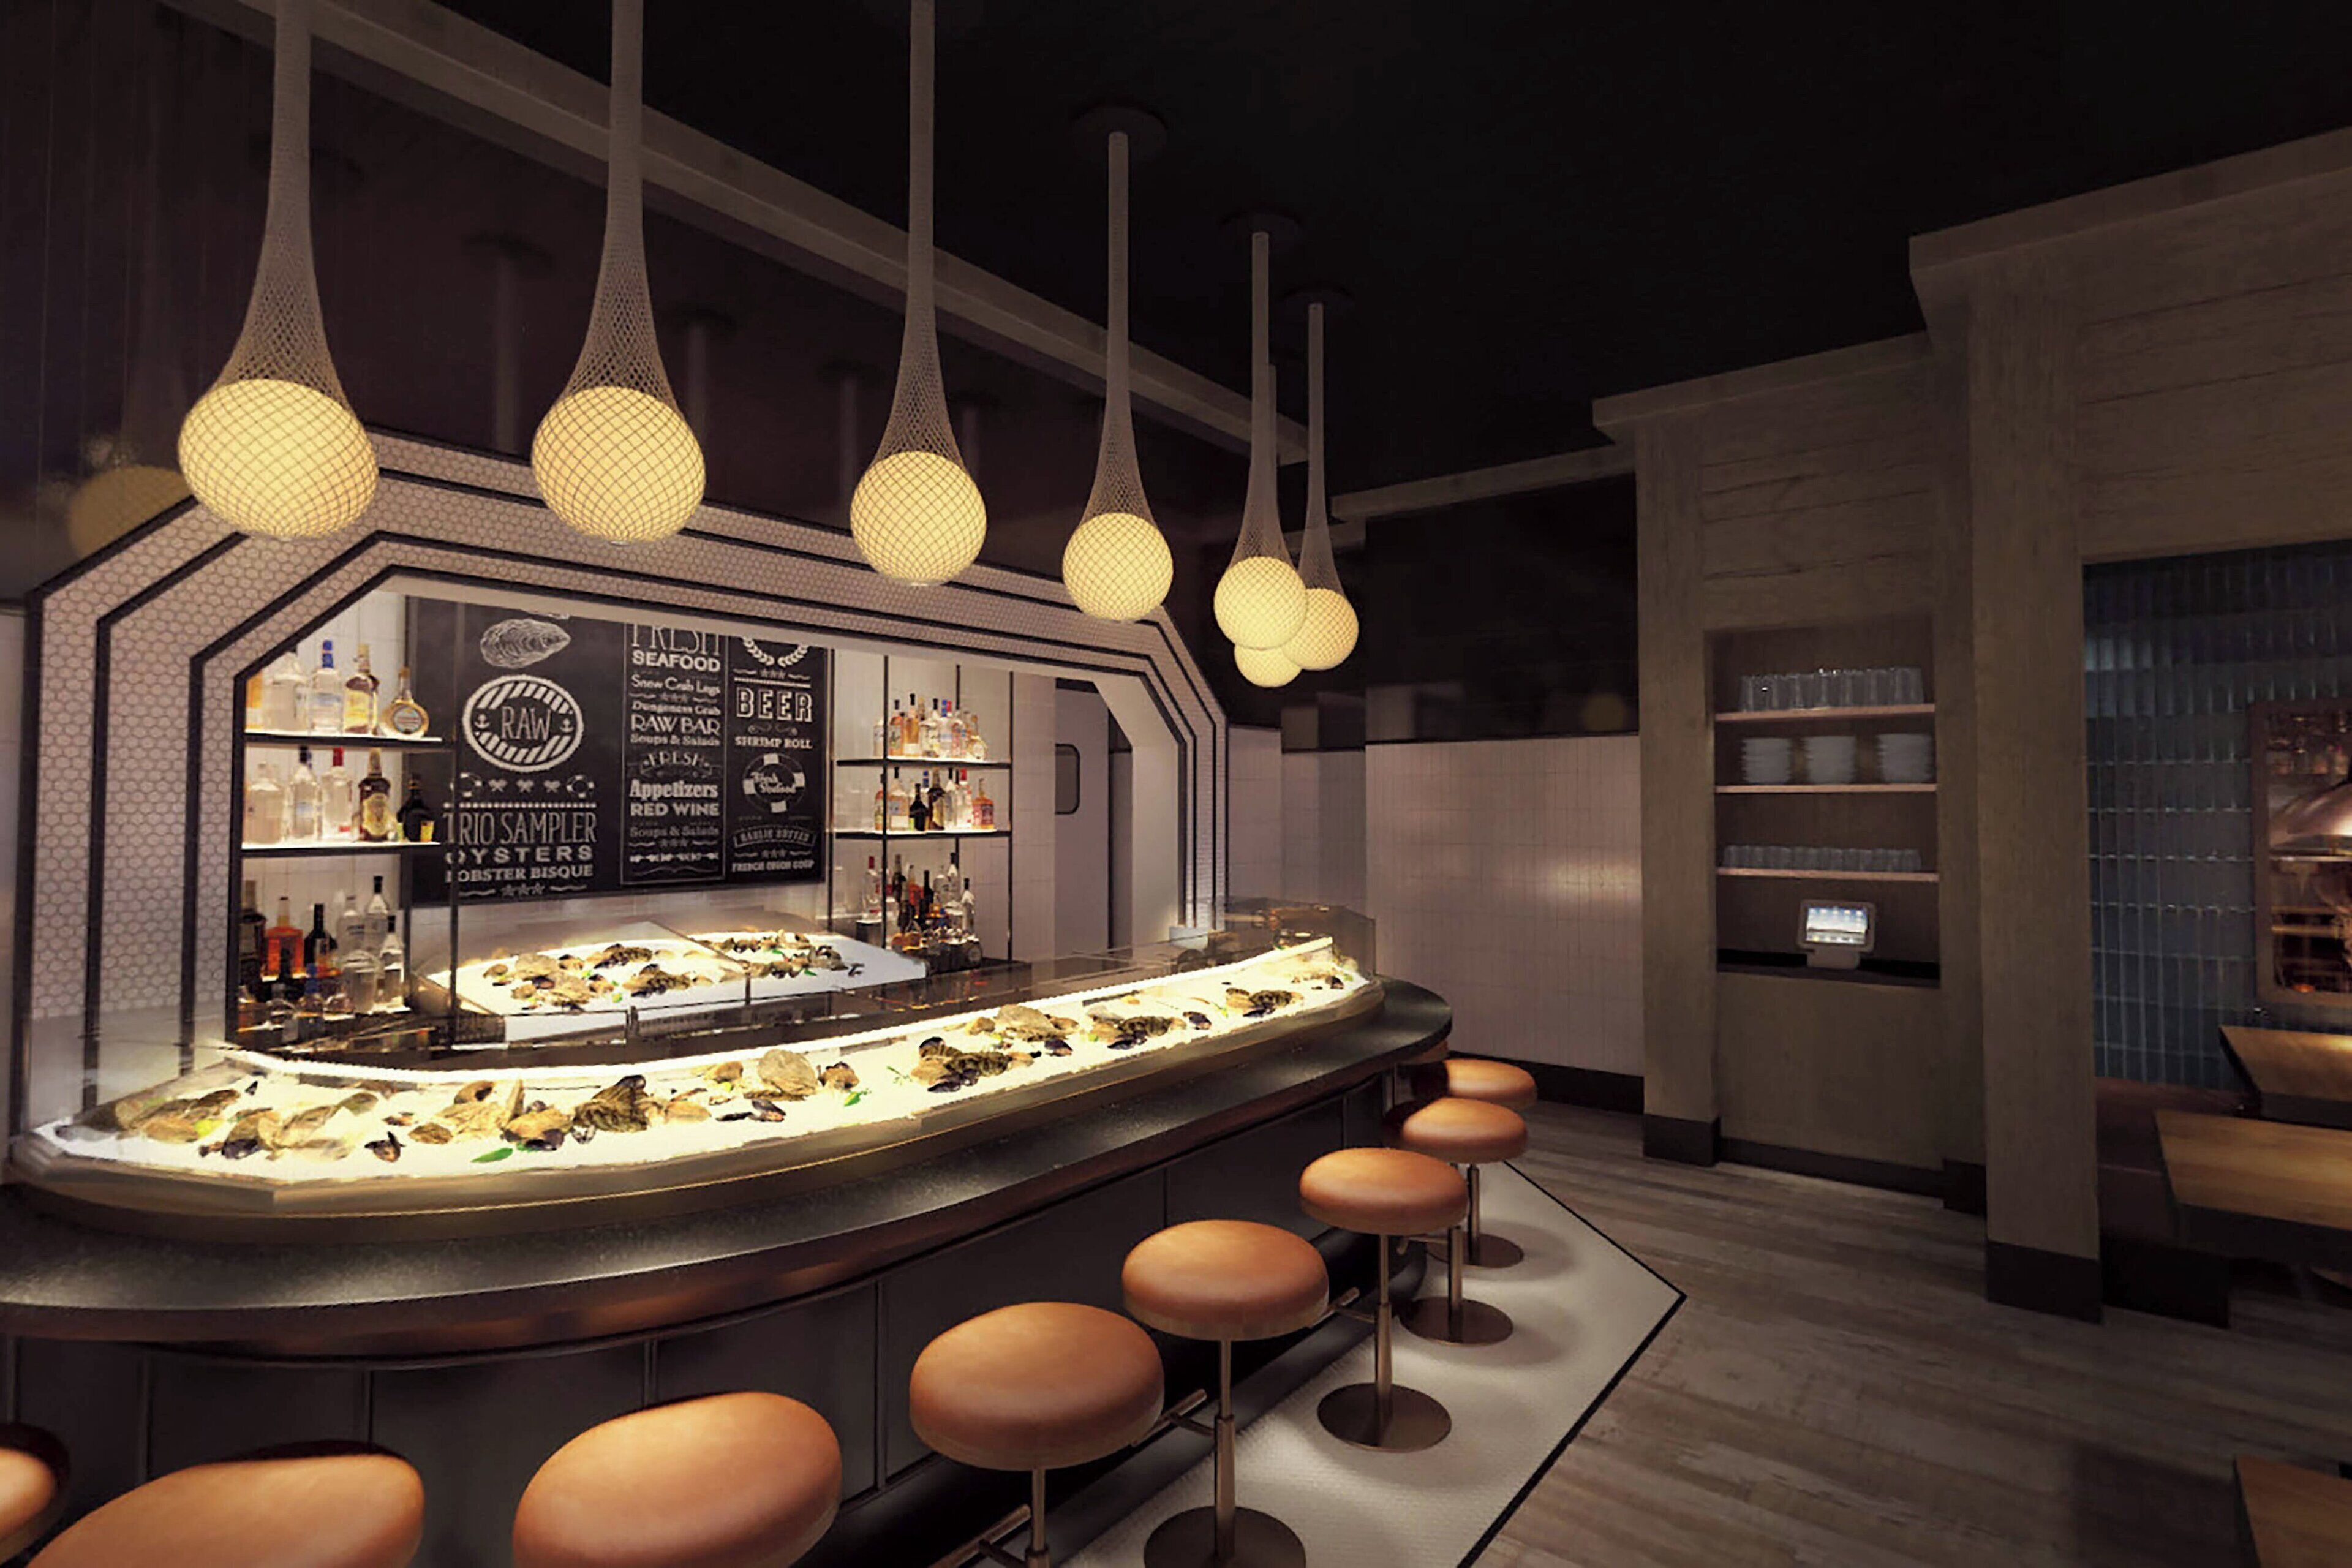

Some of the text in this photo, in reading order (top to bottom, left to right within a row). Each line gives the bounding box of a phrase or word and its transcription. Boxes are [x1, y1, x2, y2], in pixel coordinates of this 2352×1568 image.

[632, 649, 721, 673] SEAFOOD
[631, 674, 663, 688] Snow
[736, 687, 813, 723] BEER
[502, 706, 552, 742] RAW
[631, 714, 721, 736] RAW BAR
[630, 734, 720, 747] Soups & Salads
[735, 736, 813, 750] SHRIMP ROLL
[630, 778, 718, 801] Appetizers
[630, 802, 720, 817] RED WINE
[442, 812, 598, 845] TRIO SAMPLER
[445, 845, 593, 865] OYSTERS
[530, 864, 594, 880] BISQUE
